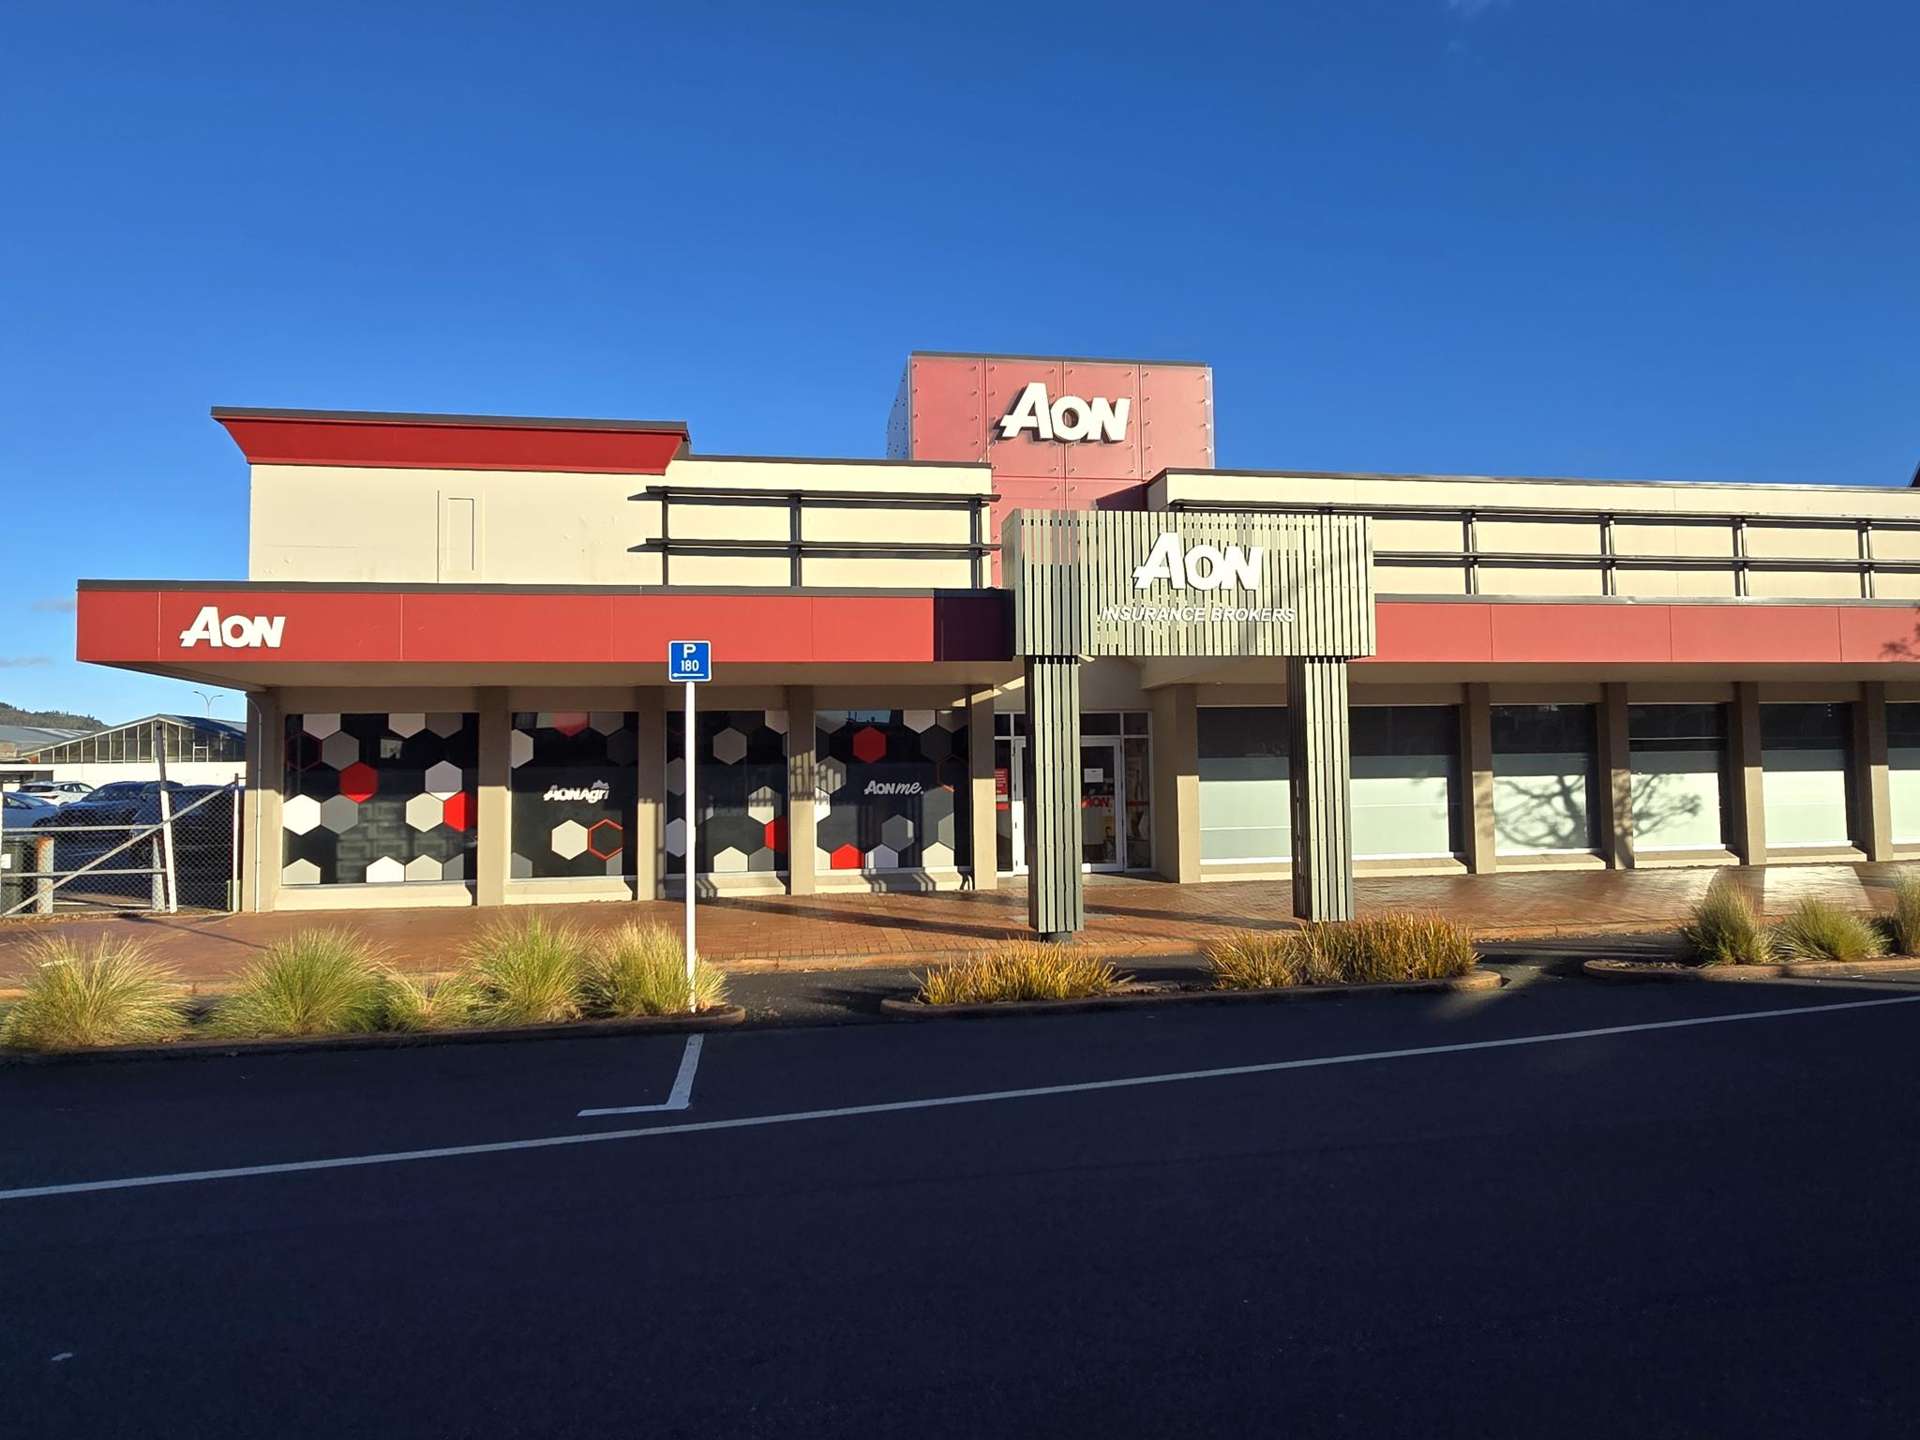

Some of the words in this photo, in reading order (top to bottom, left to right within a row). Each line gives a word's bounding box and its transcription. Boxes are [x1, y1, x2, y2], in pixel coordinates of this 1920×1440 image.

[1000, 382, 1131, 441] AON
[1131, 532, 1263, 591] AON
[179, 606, 286, 648] AON
[1101, 607, 1205, 622] INSURANCE
[1210, 608, 1296, 622] BROKERS
[683, 644, 697, 658] P
[681, 659, 699, 672] 180
